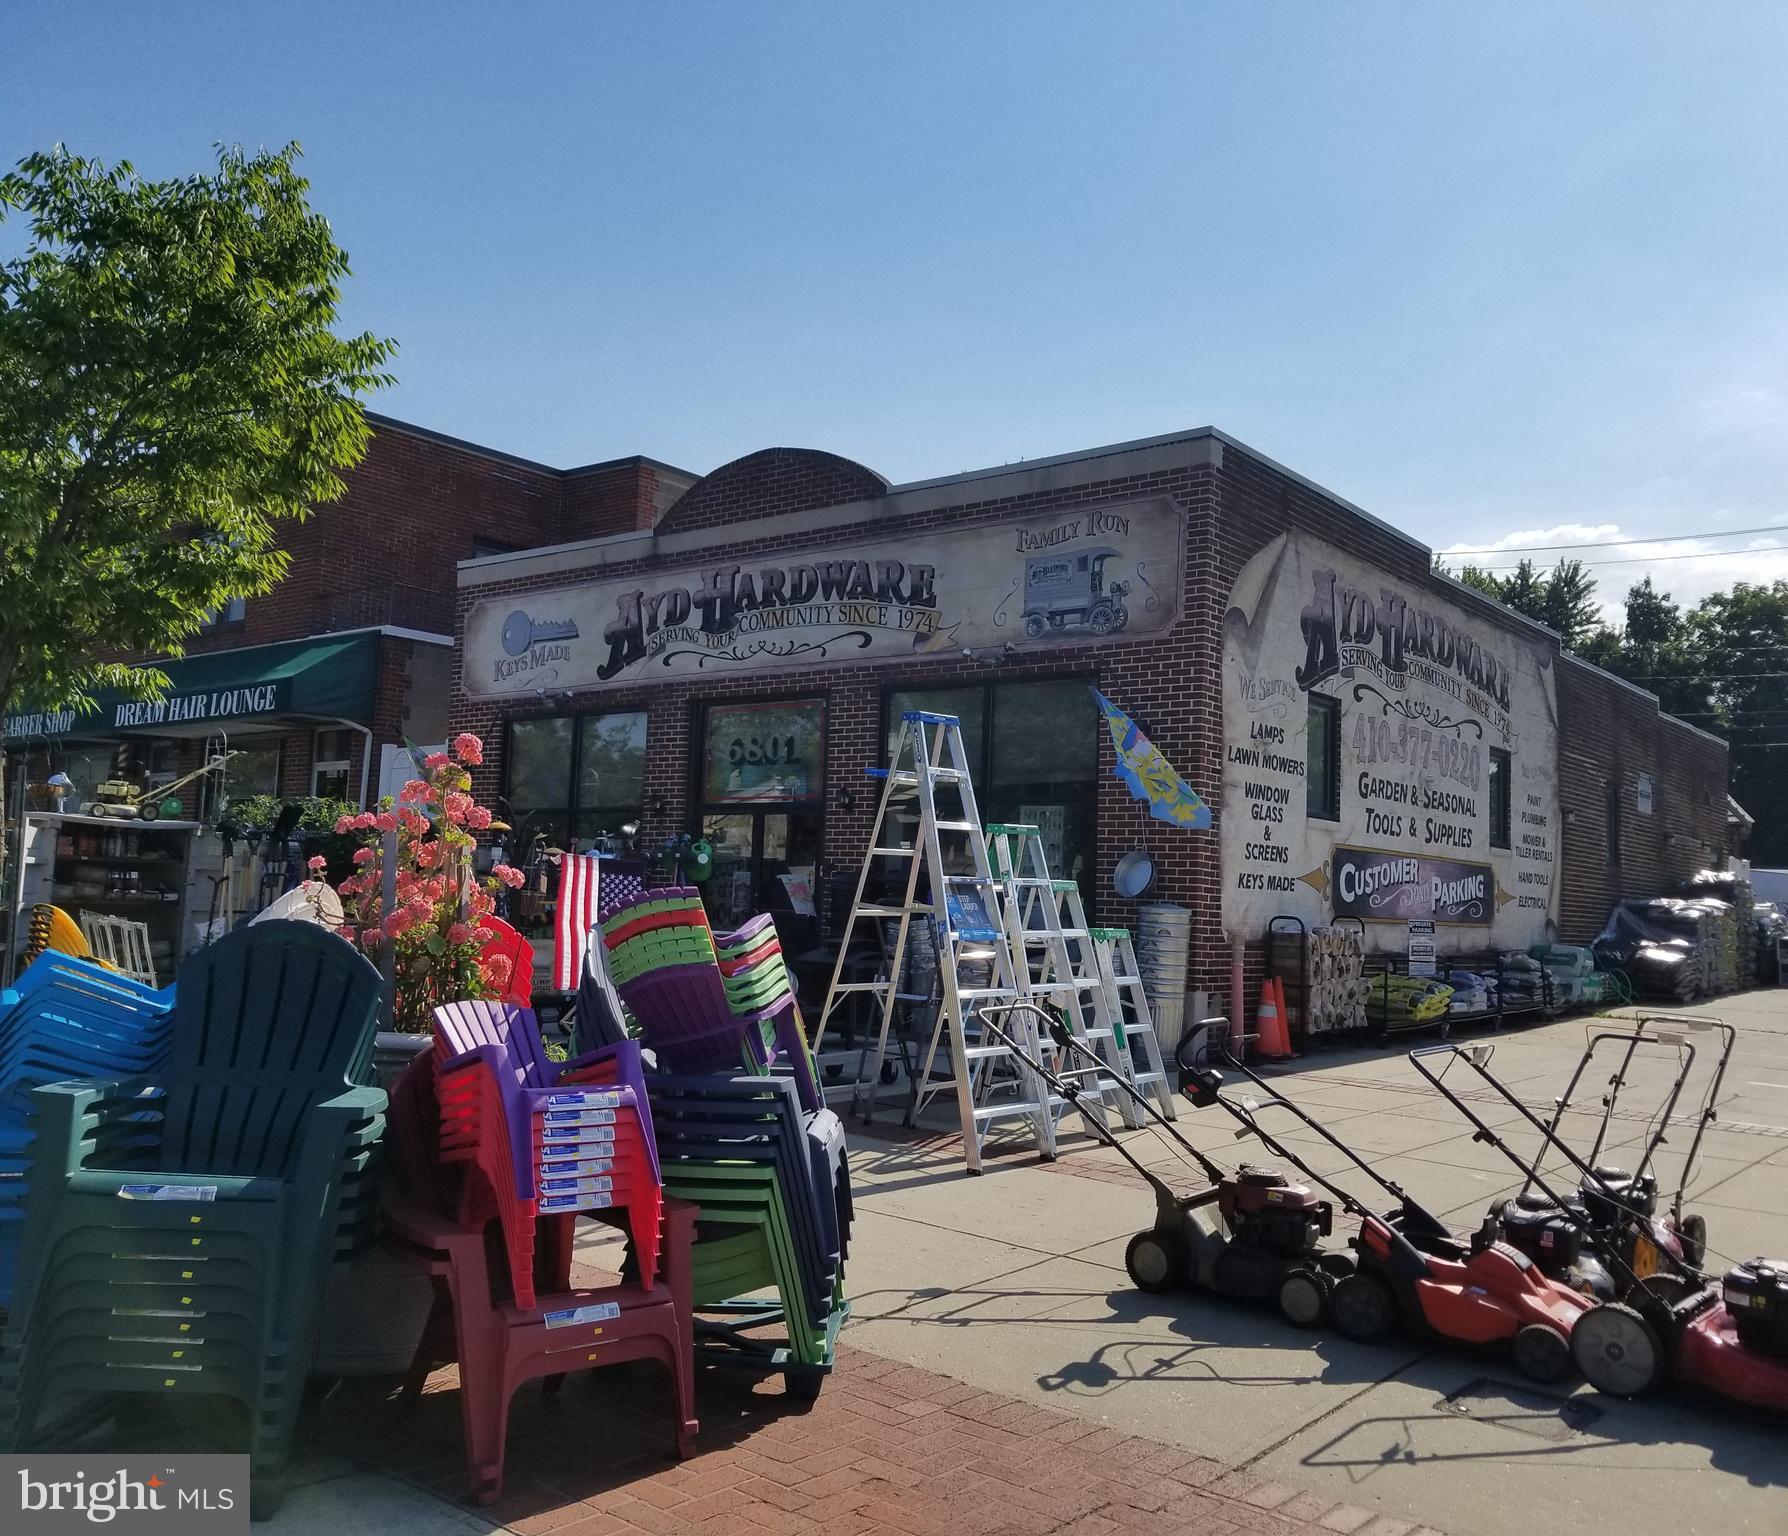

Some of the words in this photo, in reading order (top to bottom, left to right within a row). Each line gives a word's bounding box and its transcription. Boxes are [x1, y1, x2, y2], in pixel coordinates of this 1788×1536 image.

[1016, 521, 1080, 552] FAMILY
[1086, 511, 1129, 536] RUN
[651, 628, 700, 650] SERVING
[704, 631, 736, 648] YOUR
[738, 606, 834, 633] COMMUNITY
[838, 605, 888, 626] SINCE
[898, 609, 934, 632] 1974
[493, 656, 529, 682] KEYS
[530, 643, 571, 670] MADE
[1341, 649, 1383, 682] SERVING
[1385, 670, 1406, 689] YOUR
[1408, 662, 1463, 698] COMMUNITY
[1466, 691, 1490, 718] SINCE
[115, 699, 165, 727] DREAM
[168, 694, 207, 722] HAIR
[209, 685, 276, 717] LOUNGE
[45, 710, 76, 734] SHOP
[1250, 721, 1284, 744] LAMPS
[729, 735, 803, 766] 6801
[1228, 745, 1259, 767] LAWN
[1262, 754, 1304, 777] MOWERS
[1245, 781, 1290, 805] WINDOW
[1358, 771, 1408, 803] GARDEN
[1410, 785, 1419, 807] &
[1423, 786, 1477, 818] SEASONAL
[1527, 794, 1542, 807] PAINT
[1251, 803, 1283, 823] GLASS
[1263, 825, 1272, 842] &
[1365, 807, 1402, 837] TOOLS
[1409, 817, 1417, 838] &
[1424, 818, 1473, 848] SUPPLIES
[1522, 834, 1542, 848] MOWER
[1245, 843, 1289, 864] SCREENS
[1515, 846, 1533, 858] TILLER
[1532, 850, 1553, 862] RENTALS
[1238, 873, 1264, 890] KEYS
[1267, 875, 1296, 892] MADE
[1339, 858, 1419, 902] CUSTOMER
[1518, 872, 1533, 885] HAND
[1533, 873, 1549, 886] TOOLS
[1431, 874, 1484, 912] PARKING
[1518, 896, 1547, 910] ELECTRICAL
